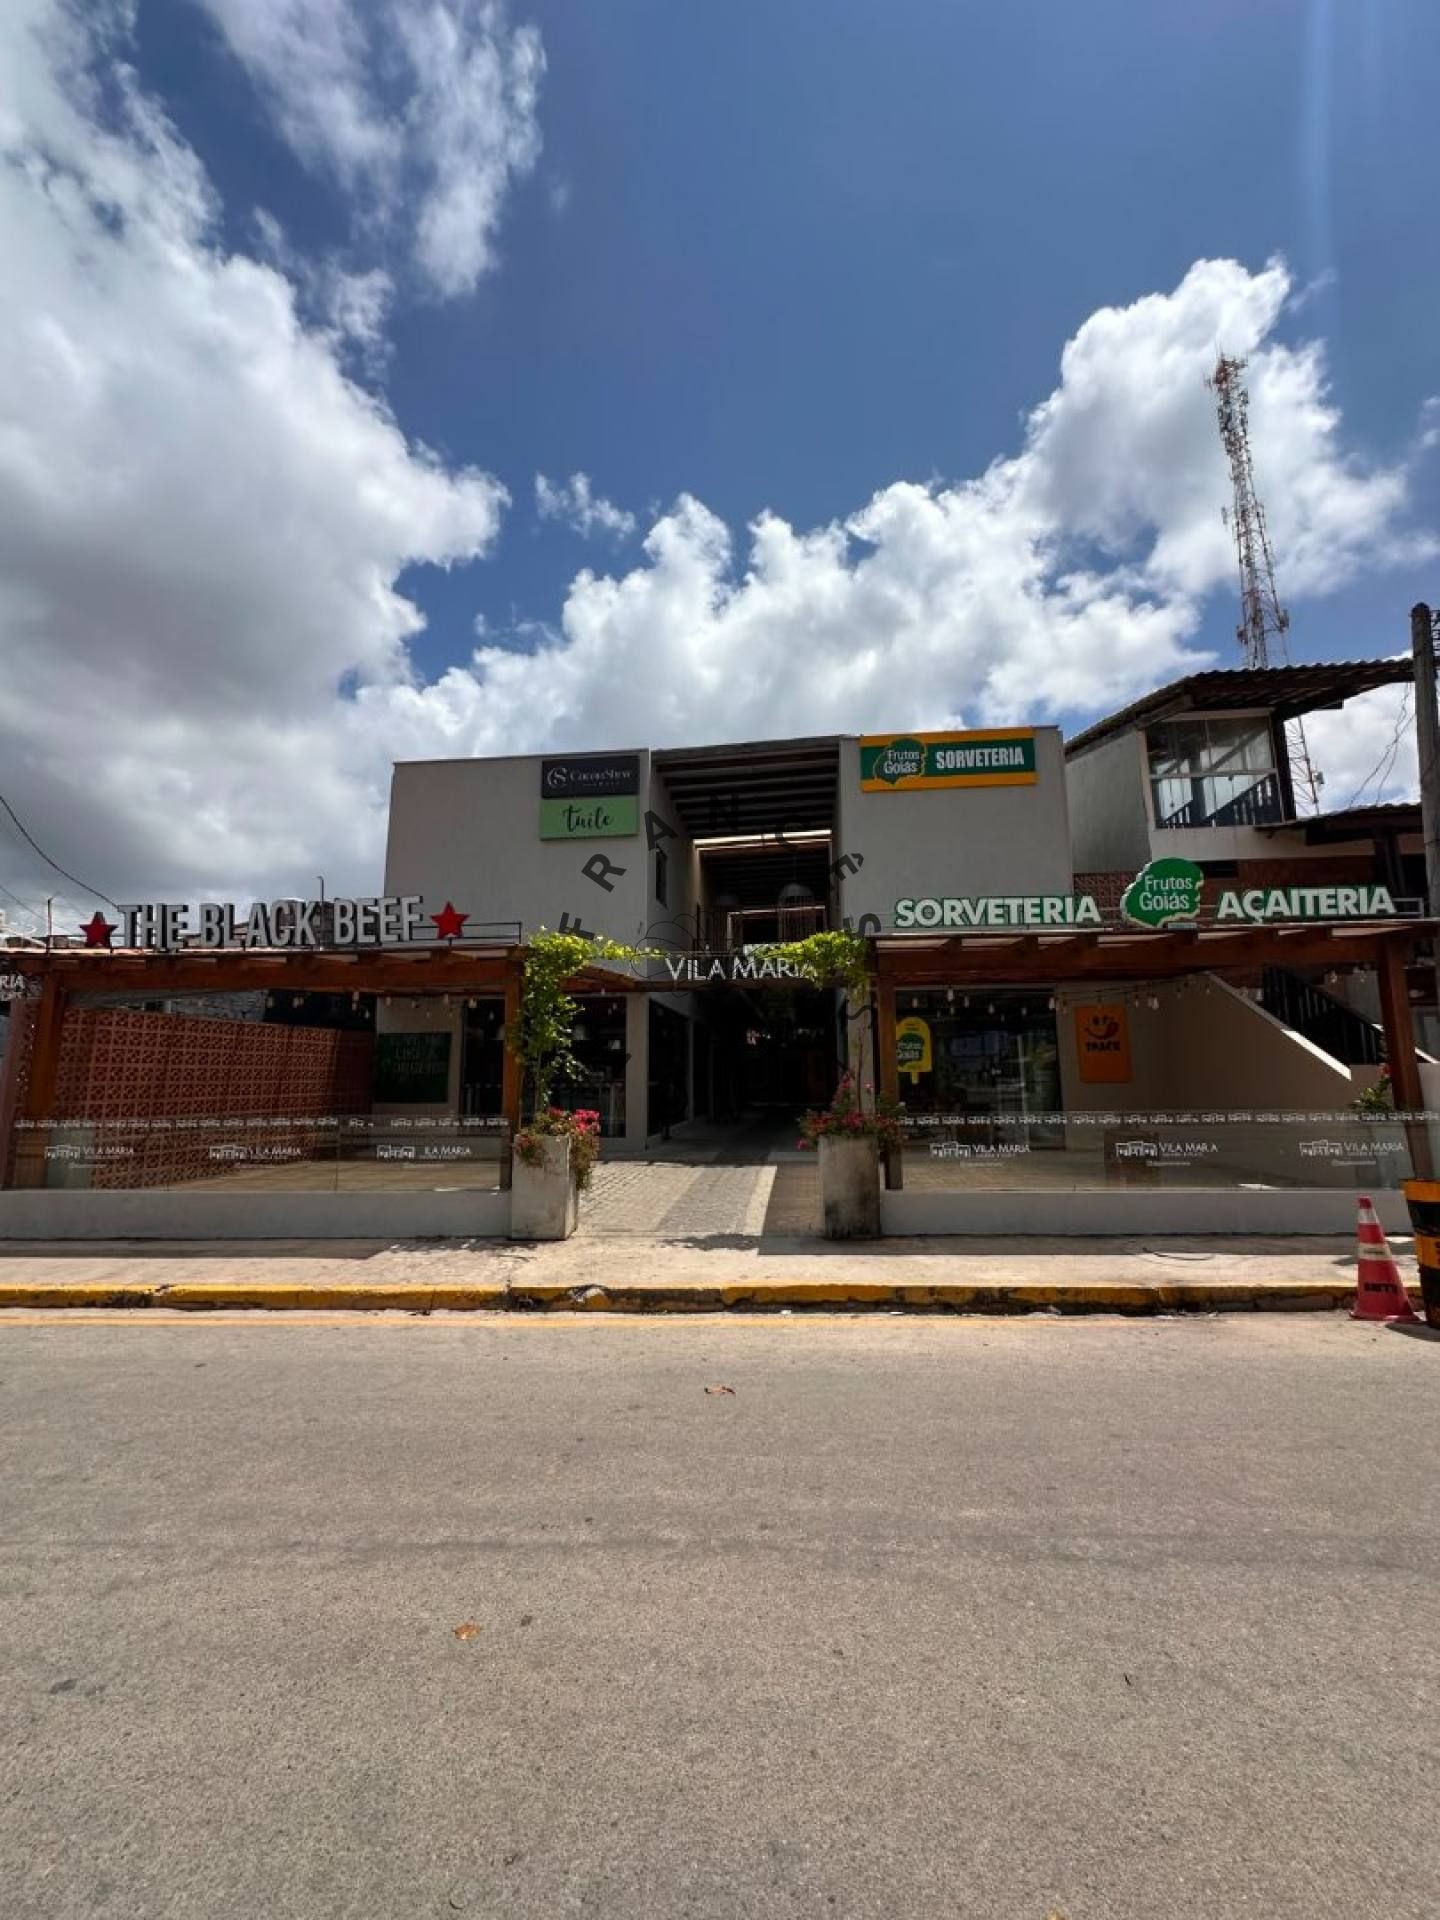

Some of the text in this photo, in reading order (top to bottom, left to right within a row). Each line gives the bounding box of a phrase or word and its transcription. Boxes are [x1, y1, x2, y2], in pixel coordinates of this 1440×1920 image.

[887, 749, 920, 760] Frutos
[935, 746, 1025, 769] SORVETERIA
[1144, 875, 1193, 891] Frutos
[895, 894, 1102, 928] SORVETERIA
[1139, 890, 1190, 911] Goiás
[1216, 885, 1398, 926] AÇAITERIA
[117, 895, 424, 949] THE BLACK BEEF
[664, 955, 819, 982] VILA MARIA
[971, 1144, 1032, 1153] VILA MARIA
[1158, 1142, 1219, 1153] VILA MARA
